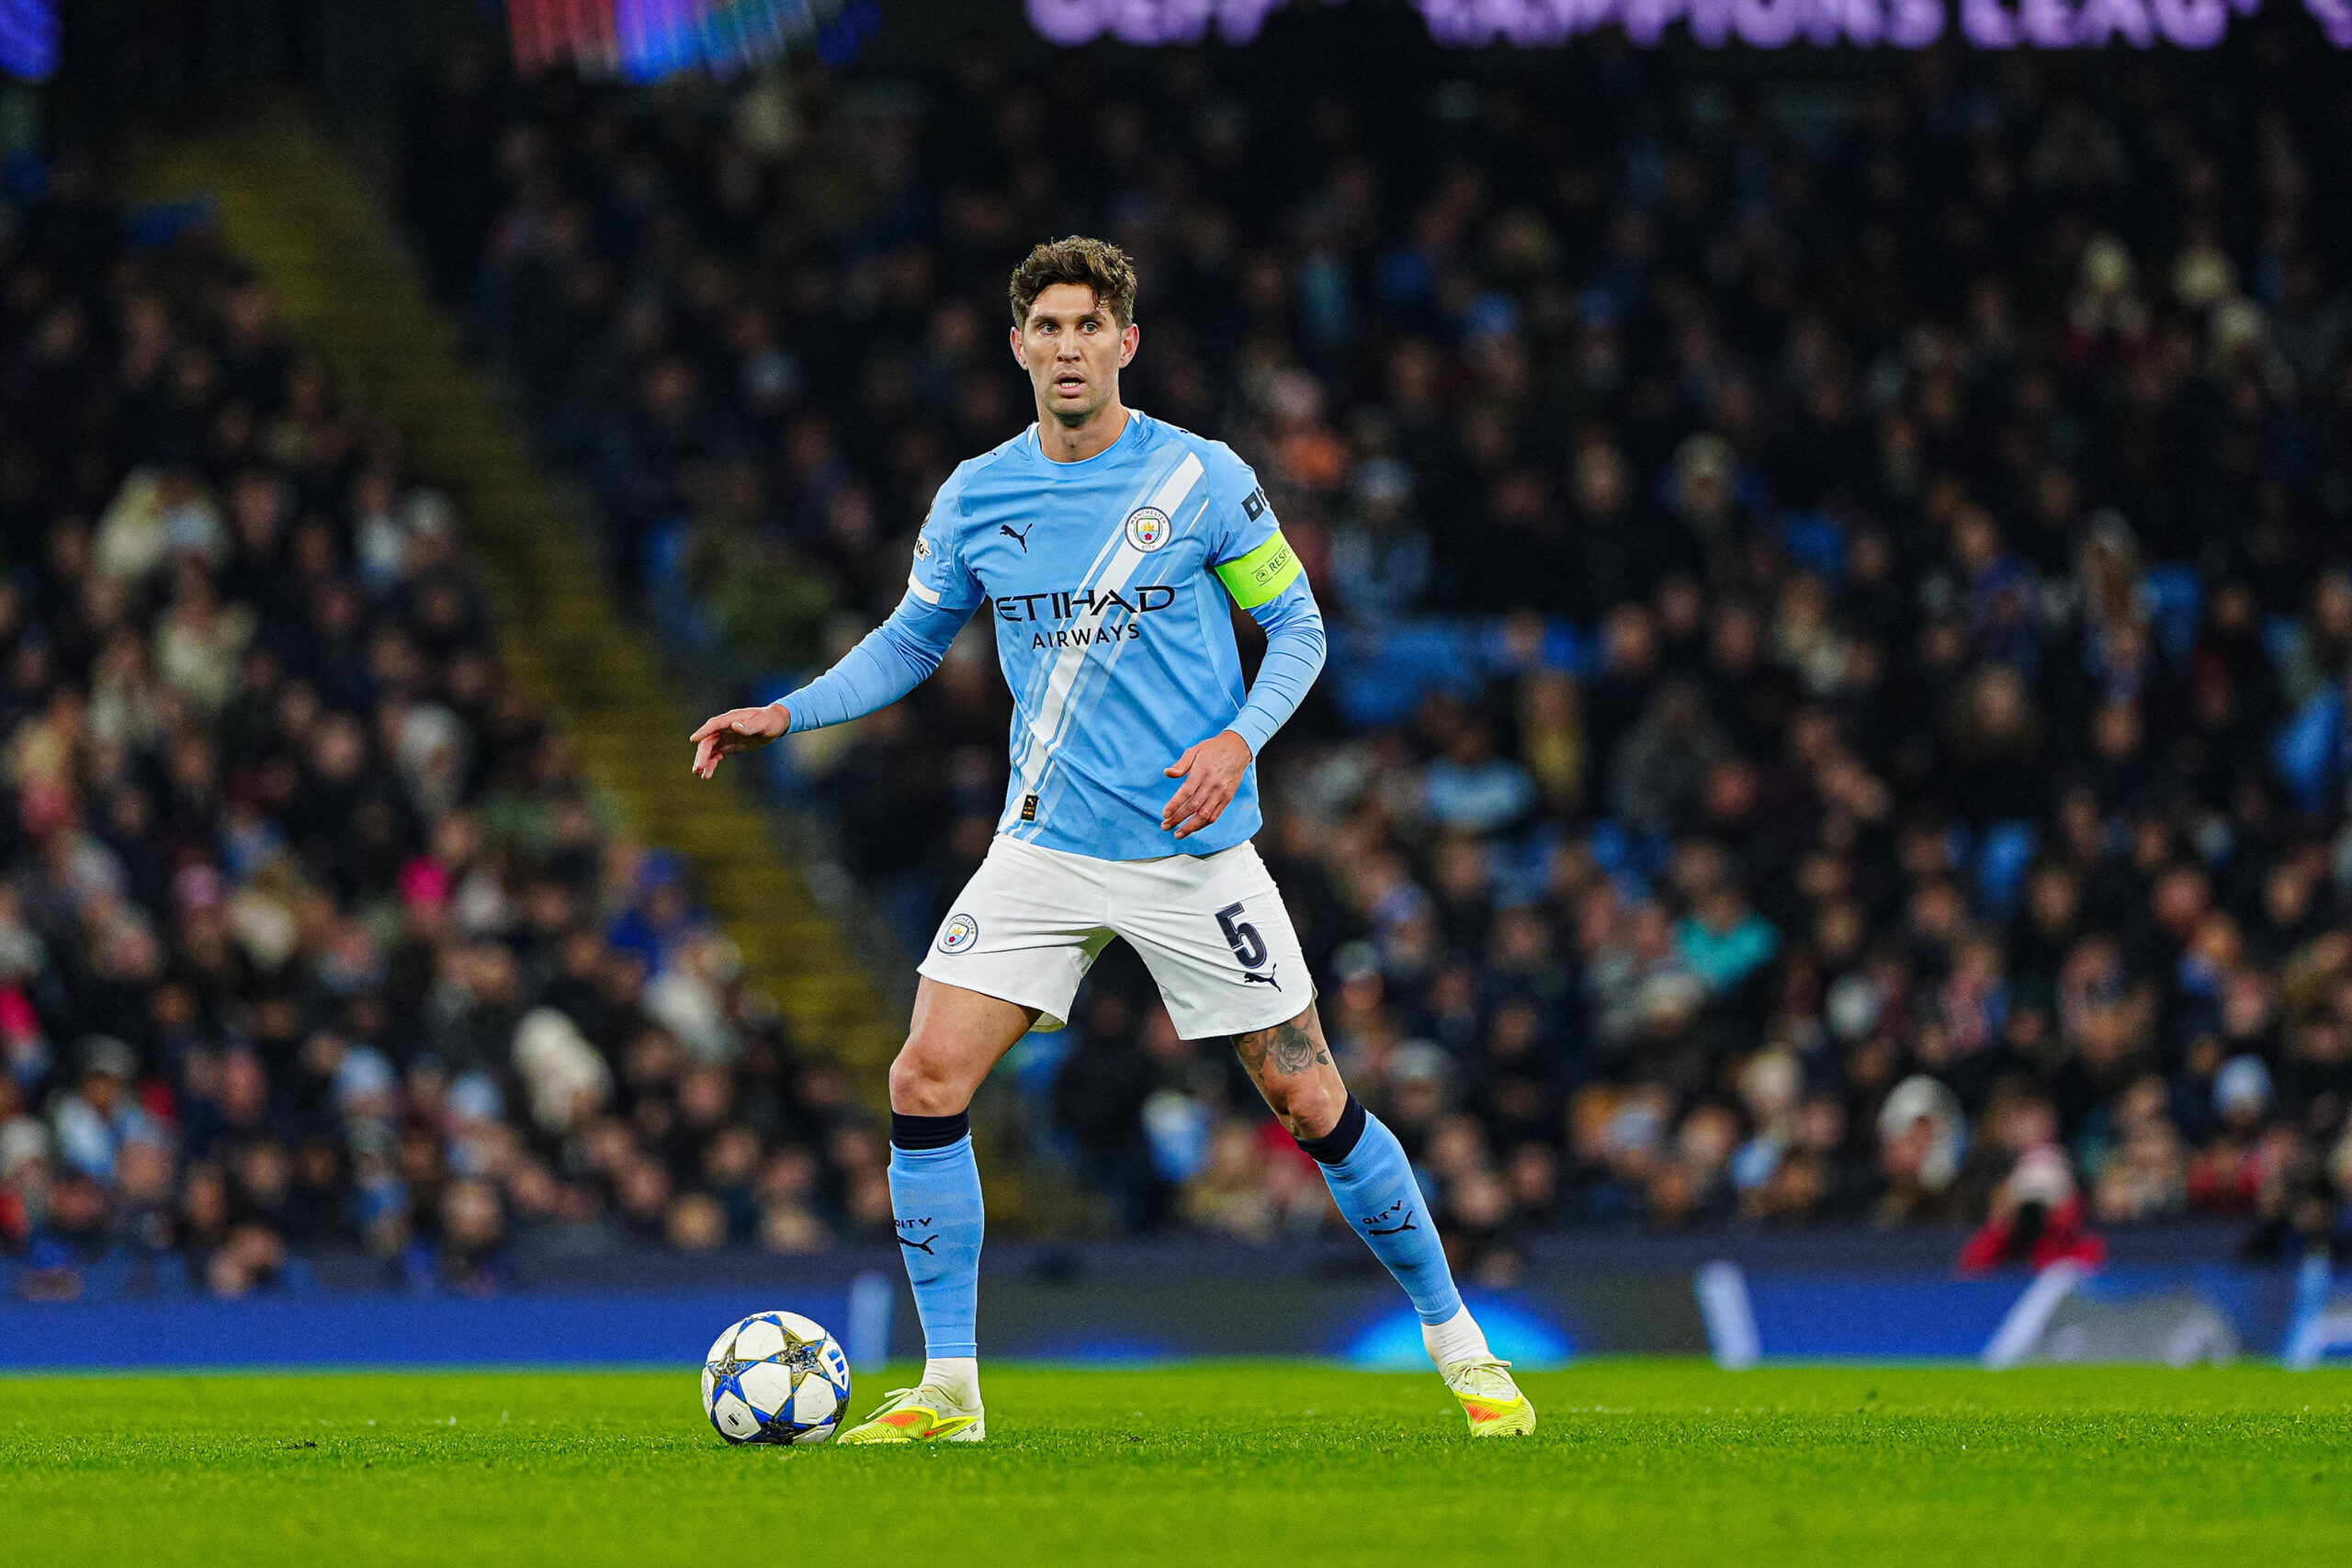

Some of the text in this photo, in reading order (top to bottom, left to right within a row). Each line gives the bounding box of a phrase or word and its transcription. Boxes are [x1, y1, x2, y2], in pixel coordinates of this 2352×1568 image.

[1130, 510, 1167, 525] MANCHESTER
[995, 585, 1176, 623] ETIHAD
[1032, 623, 1140, 650] AIRWAYS
[1214, 901, 1268, 969] 5
